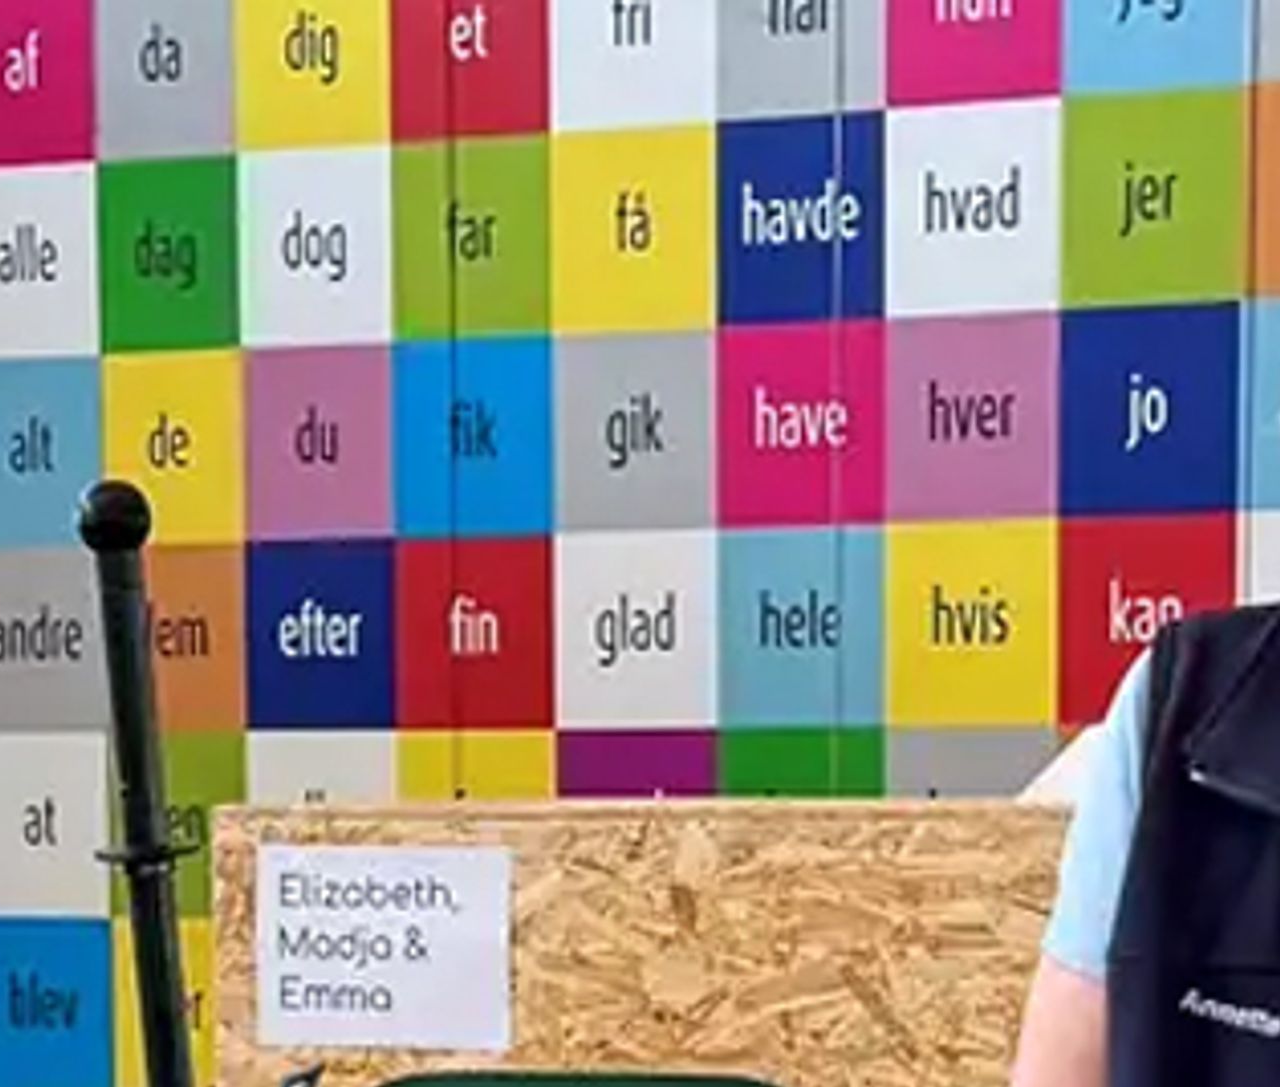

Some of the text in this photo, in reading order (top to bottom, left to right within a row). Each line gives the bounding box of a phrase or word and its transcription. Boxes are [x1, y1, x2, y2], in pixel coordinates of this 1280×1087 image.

[5, 30, 38, 91] af
[140, 25, 181, 82] da
[285, 11, 338, 85] dig
[451, 12, 486, 60] et
[616, 192, 650, 251] få
[743, 180, 859, 246] havde
[926, 166, 1020, 233] hvad
[1120, 162, 1177, 237] jer
[135, 219, 197, 290] dag
[282, 211, 346, 282] dog
[448, 202, 494, 262] far
[148, 412, 190, 468] de
[295, 406, 338, 464] du
[450, 399, 496, 458] fik
[606, 394, 663, 469] gik
[756, 387, 847, 448] have
[929, 380, 1014, 441] hver
[1126, 374, 1167, 449] jo
[9, 417, 53, 473] alt
[147, 600, 209, 658] em
[279, 599, 361, 656] efter
[450, 596, 498, 653] fin
[596, 593, 675, 667] glad
[760, 590, 841, 648] hele
[933, 585, 1008, 644] hvis
[24, 798, 56, 846] at
[280, 872, 459, 913] Elizabeth,
[403, 926, 427, 960] &
[9, 972, 79, 1029] blev
[280, 975, 392, 1011] Emma
